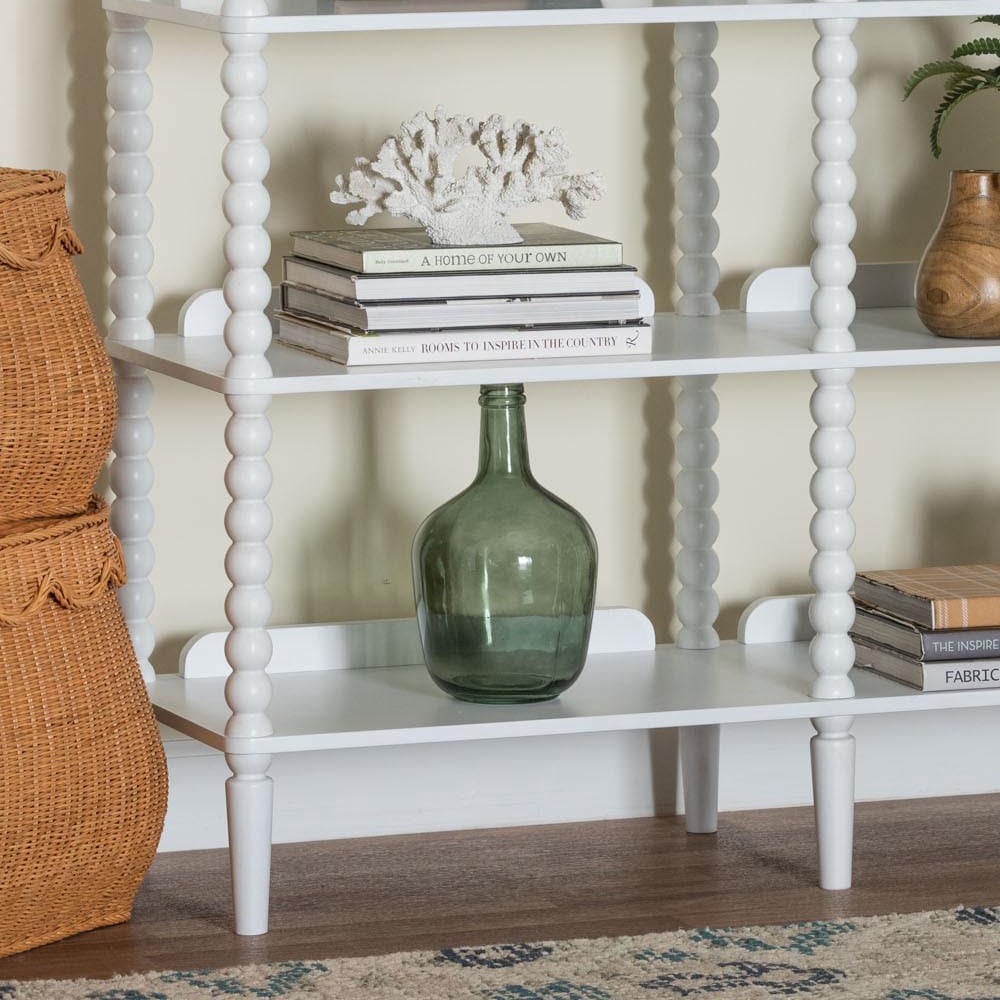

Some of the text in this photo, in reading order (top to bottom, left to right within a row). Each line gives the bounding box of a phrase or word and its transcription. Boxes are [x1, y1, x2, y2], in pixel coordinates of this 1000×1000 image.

[421, 255, 431, 267] A
[535, 251, 567, 263] OWN
[362, 345, 416, 356] ANNIE KELLY
[421, 336, 617, 354] ROOMS TO INSPIRE IN THE COUNTRY
[932, 641, 955, 652] THE
[945, 668, 1000, 684] FABRIC
